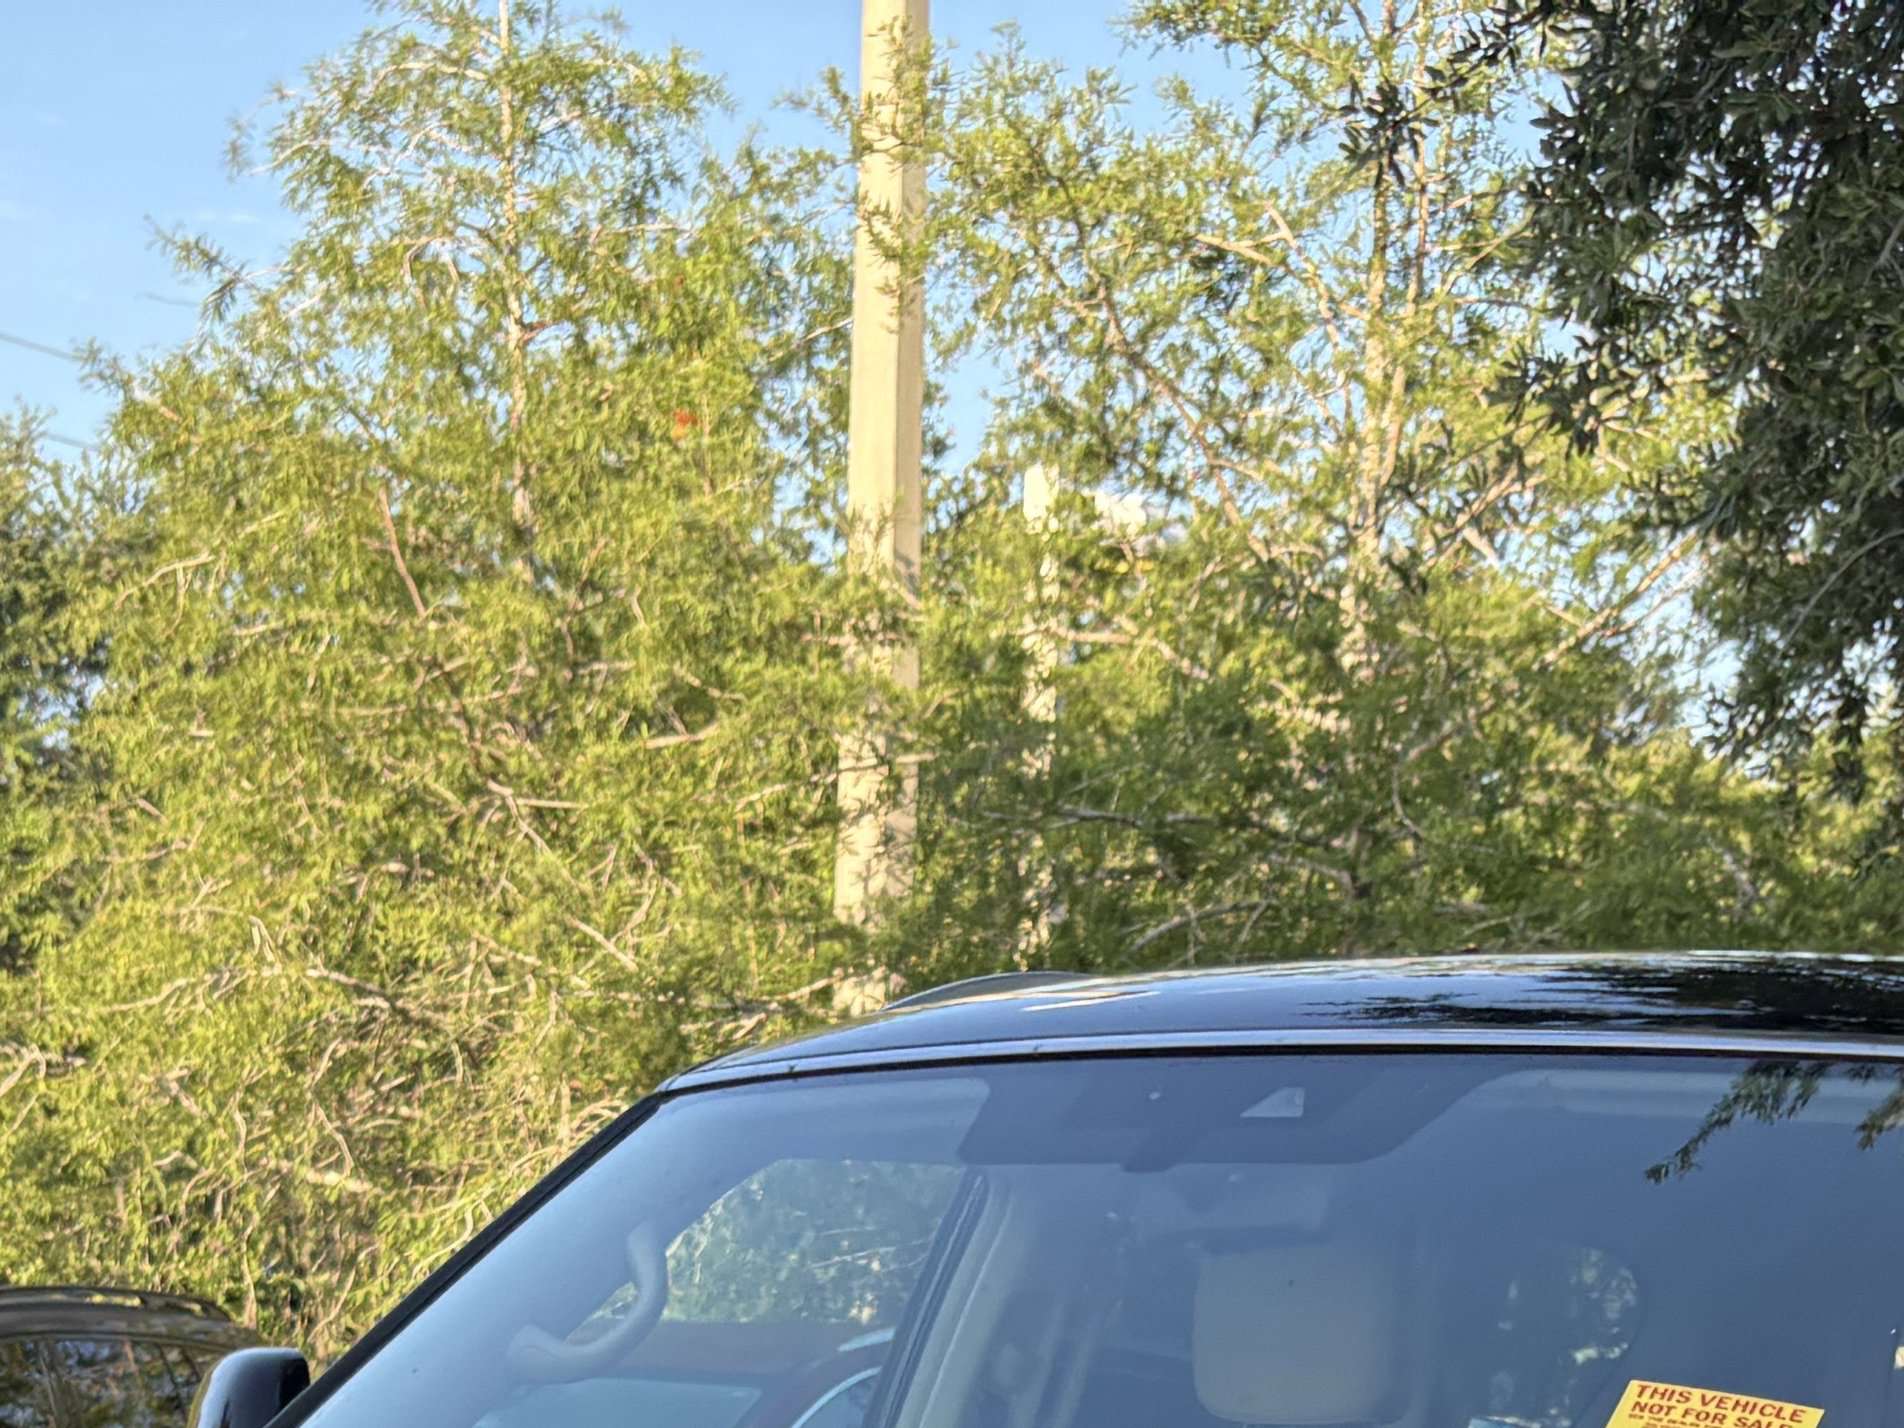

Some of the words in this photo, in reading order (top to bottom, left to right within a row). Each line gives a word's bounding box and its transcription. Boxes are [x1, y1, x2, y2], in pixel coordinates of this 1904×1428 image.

[1631, 1401, 1677, 1417] NOT
[1681, 1408, 1727, 1425] FOR
[1636, 1385, 1693, 1404] THIS
[1701, 1394, 1807, 1423] VEHICLE
